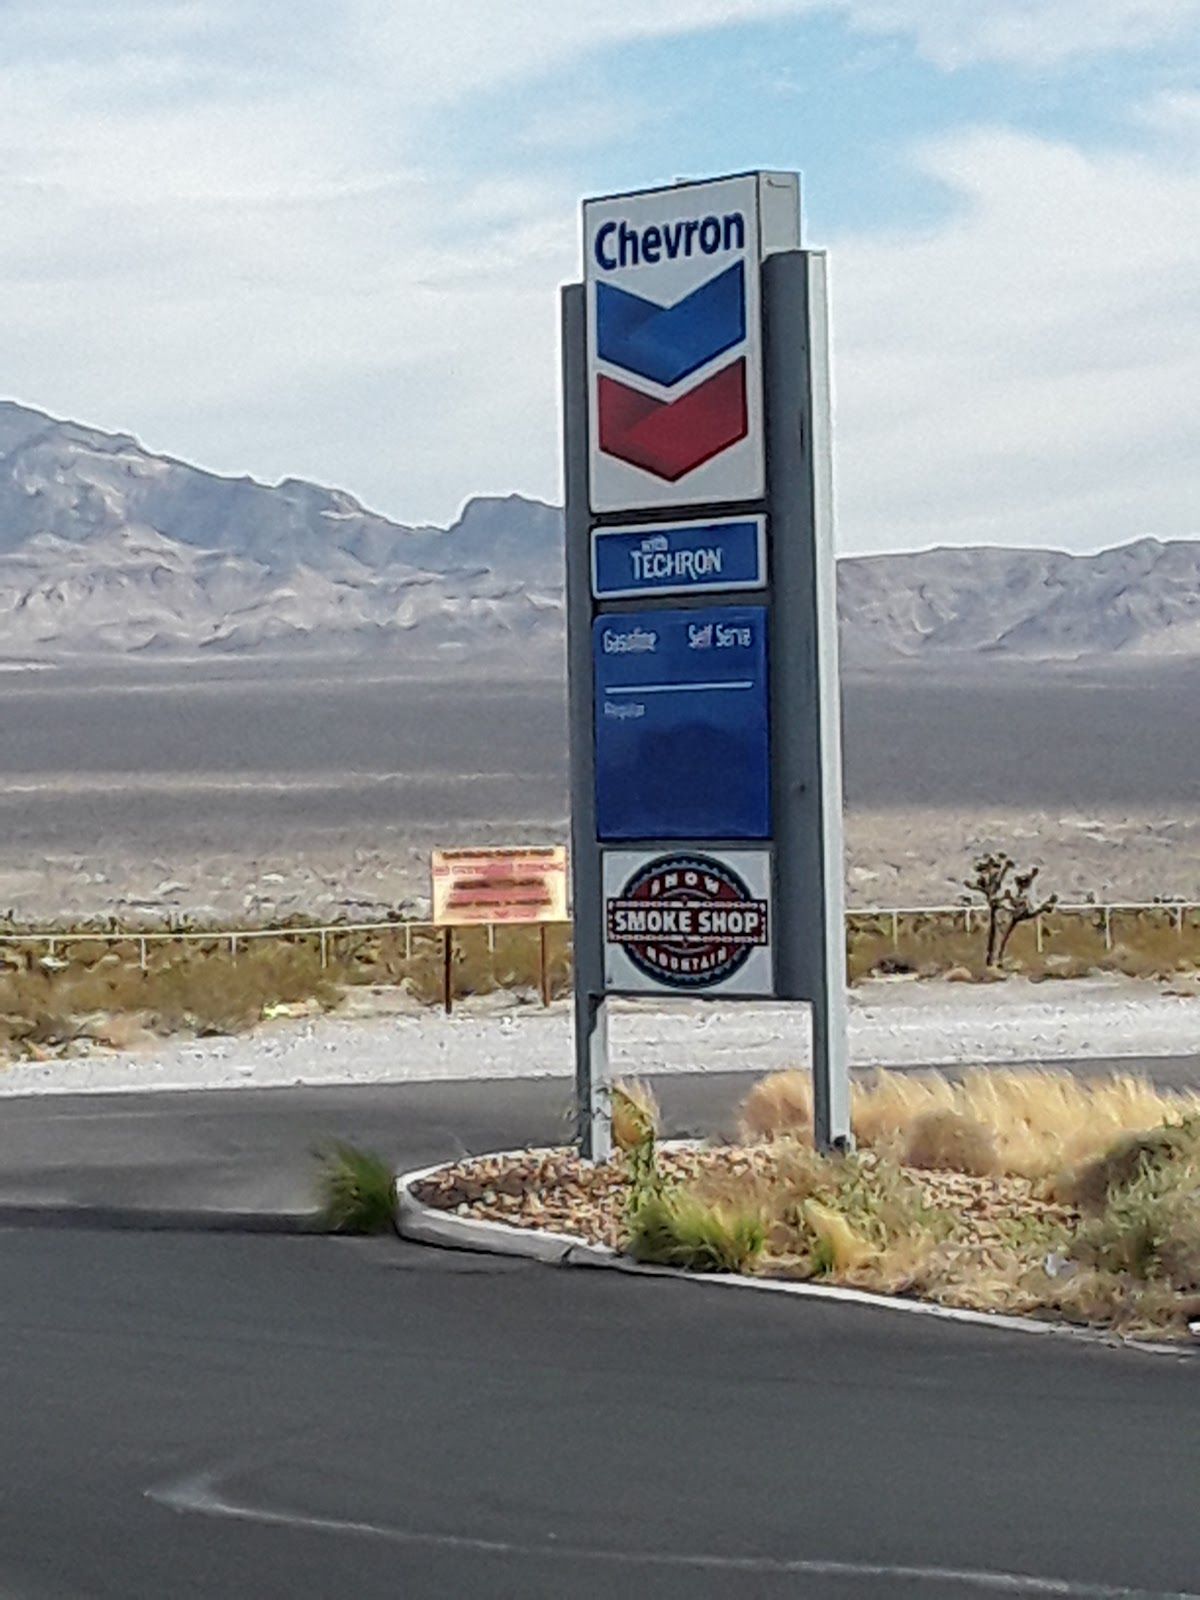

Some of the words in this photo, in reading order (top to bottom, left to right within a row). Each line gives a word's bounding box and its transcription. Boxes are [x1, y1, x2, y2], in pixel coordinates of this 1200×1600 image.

[594, 212, 744, 270] Chevron
[630, 548, 722, 580] TECHRON
[614, 910, 692, 932] SMOKE
[698, 911, 759, 933] SHOP
